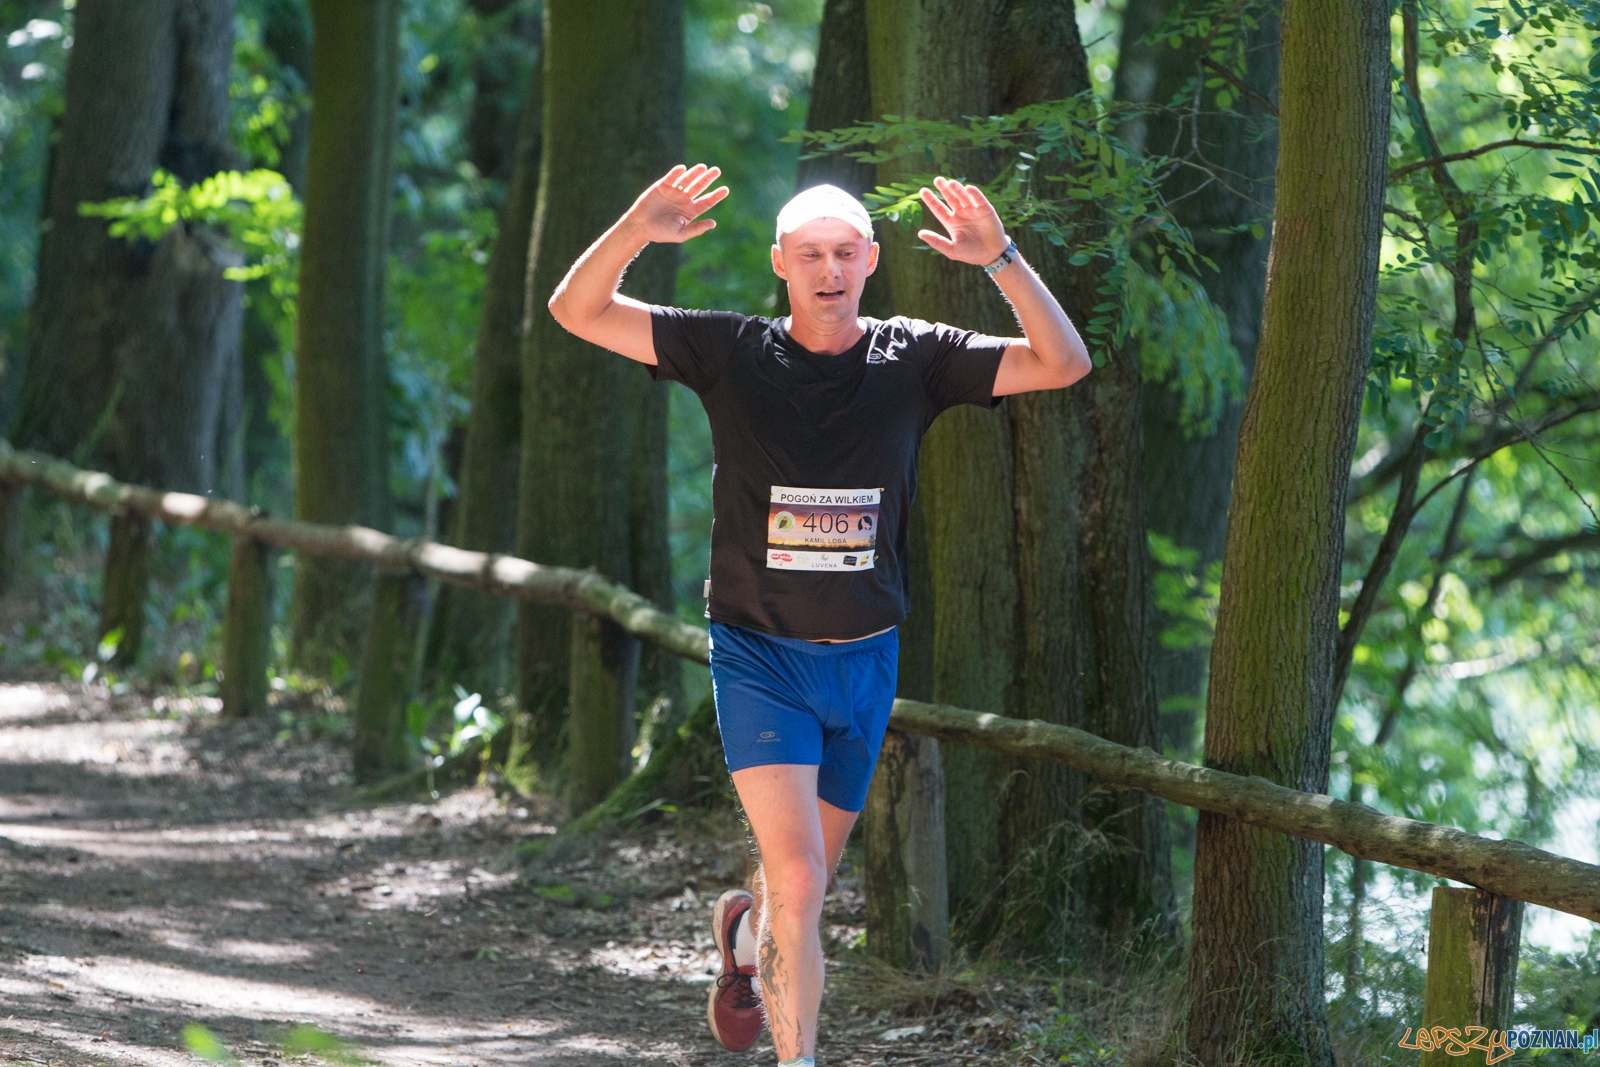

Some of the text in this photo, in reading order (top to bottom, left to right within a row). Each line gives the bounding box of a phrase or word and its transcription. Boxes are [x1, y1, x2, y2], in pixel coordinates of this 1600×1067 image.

[780, 493, 874, 504] POGOŃ ZA WILKIEM
[802, 512, 849, 534] 406
